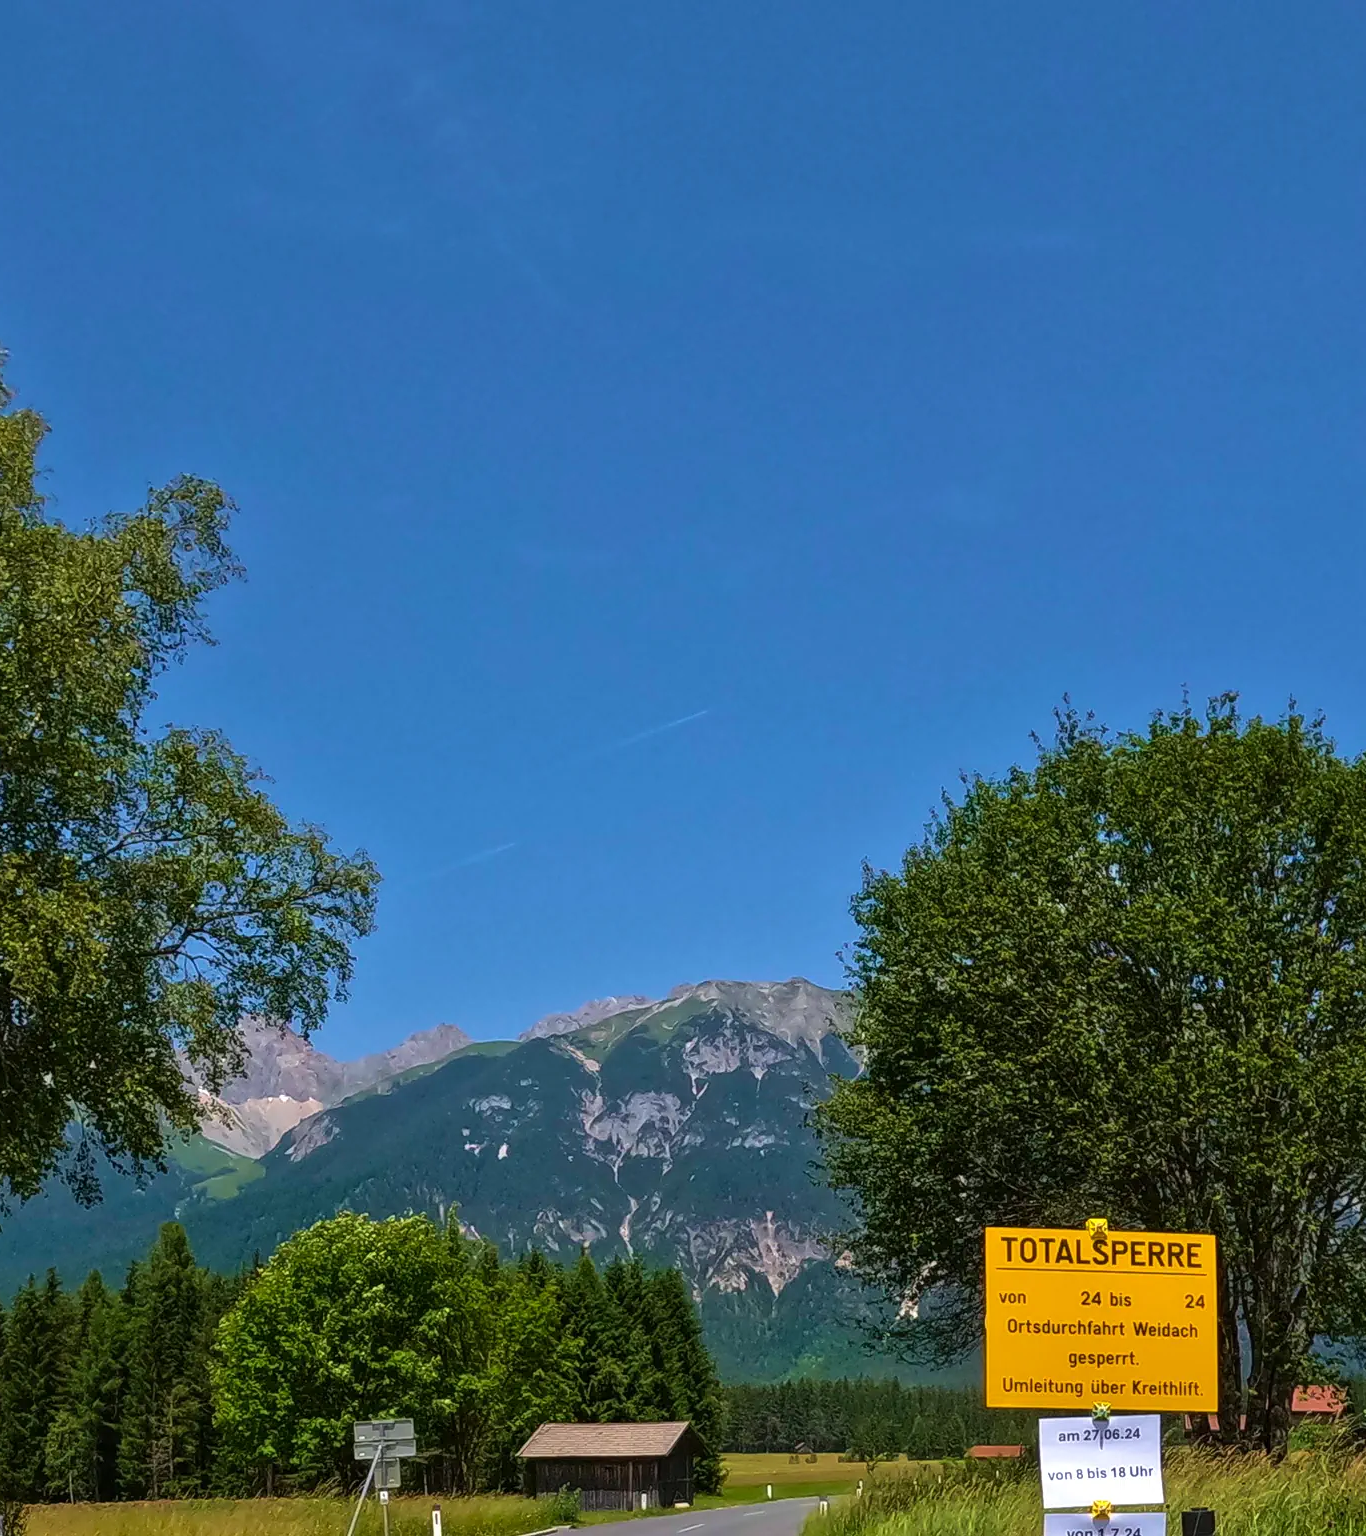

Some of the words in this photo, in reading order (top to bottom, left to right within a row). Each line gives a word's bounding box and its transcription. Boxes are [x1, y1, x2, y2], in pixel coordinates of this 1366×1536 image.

[1001, 1237, 1202, 1268] TOTALSPERRE
[999, 1292, 1026, 1304] von
[1081, 1291, 1102, 1306] 24
[1110, 1292, 1132, 1307] bis
[1185, 1295, 1205, 1309] 24
[1007, 1318, 1125, 1336] Ortsdurchfahrt
[1133, 1321, 1198, 1338] Weidach
[1068, 1351, 1140, 1368] gesperrt.
[1002, 1378, 1084, 1397] Umleitung
[1091, 1380, 1126, 1395] über
[1132, 1380, 1204, 1397] Kreithlift.
[1058, 1431, 1080, 1442] am
[1048, 1469, 1073, 1481] von
[1076, 1469, 1083, 1480] 8
[1087, 1468, 1107, 1479] bis
[1110, 1467, 1126, 1478] 18
[1129, 1466, 1154, 1478] Uhr
